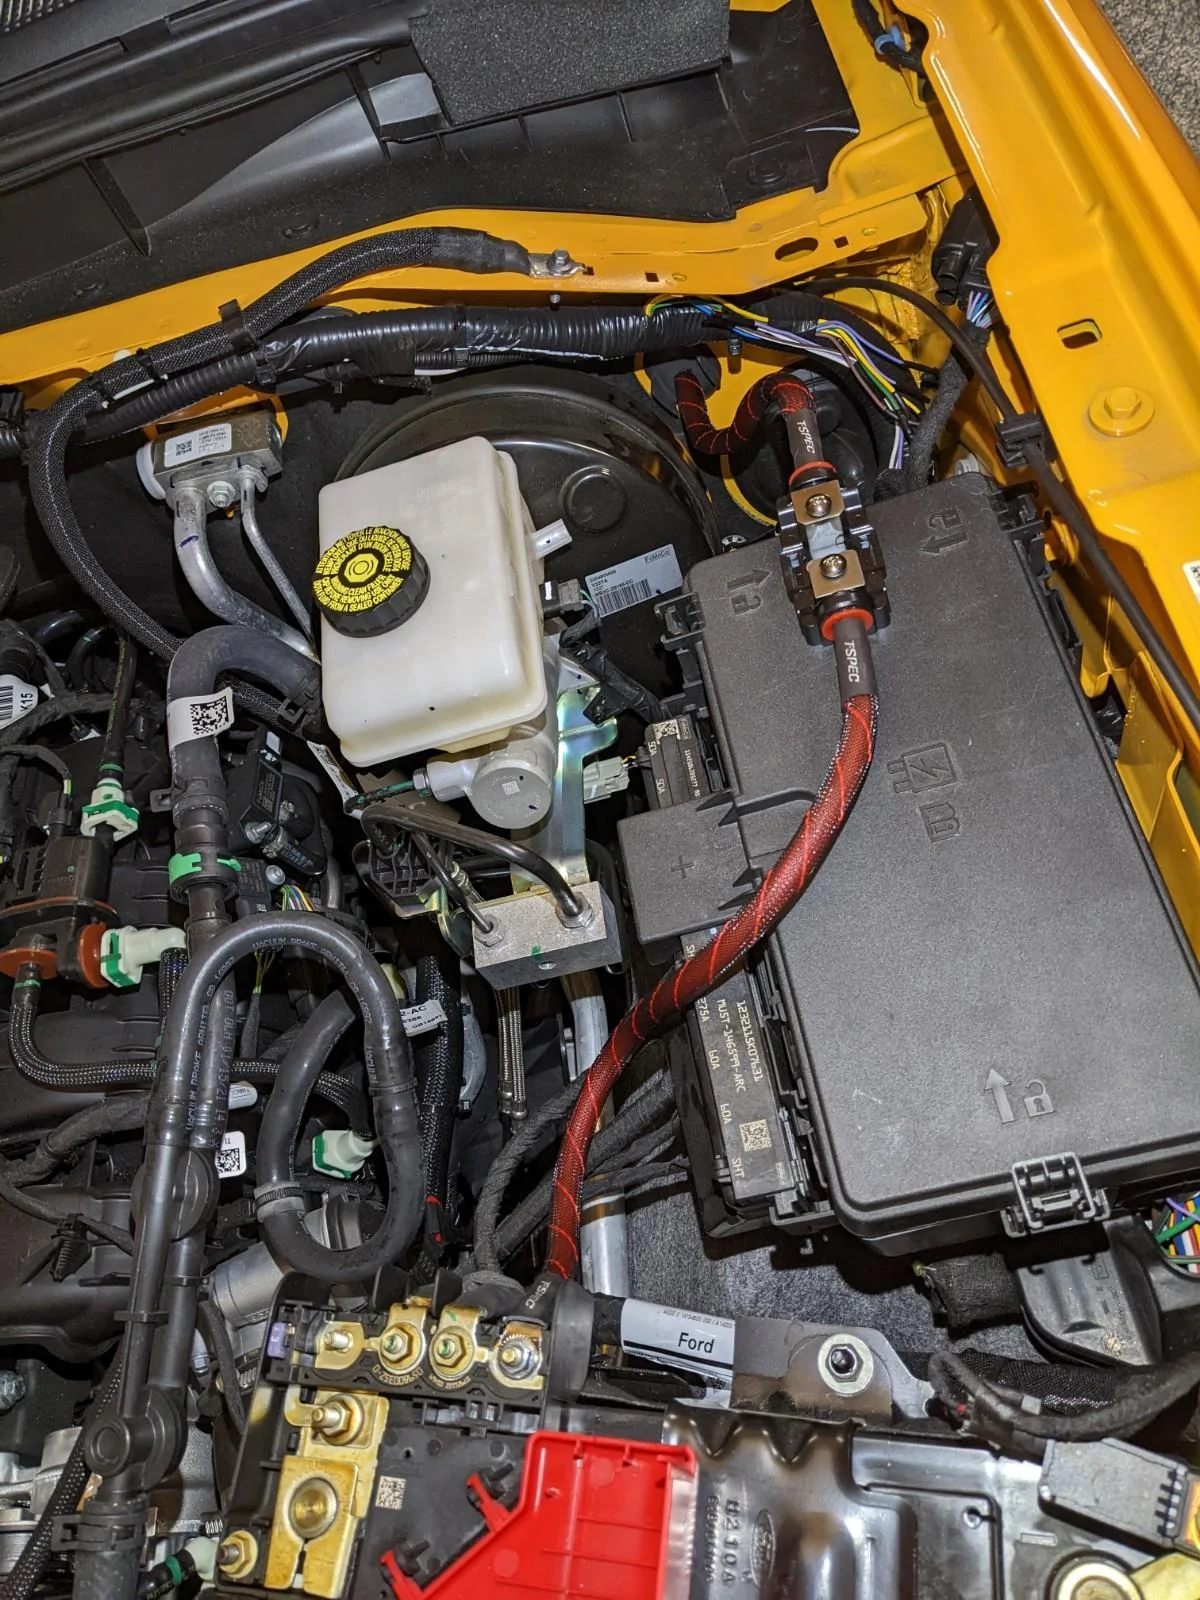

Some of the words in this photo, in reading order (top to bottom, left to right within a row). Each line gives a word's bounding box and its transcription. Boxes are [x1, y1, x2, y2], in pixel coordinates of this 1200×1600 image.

[326, 600, 345, 612] FROM
[349, 599, 373, 613] SEALED
[372, 577, 403, 605] CONTAINER
[340, 591, 371, 604] REMOVING
[370, 585, 385, 597] USE
[348, 587, 367, 596] CLEAN
[731, 1157, 745, 1178] SHT
[678, 1331, 715, 1354] Ford
